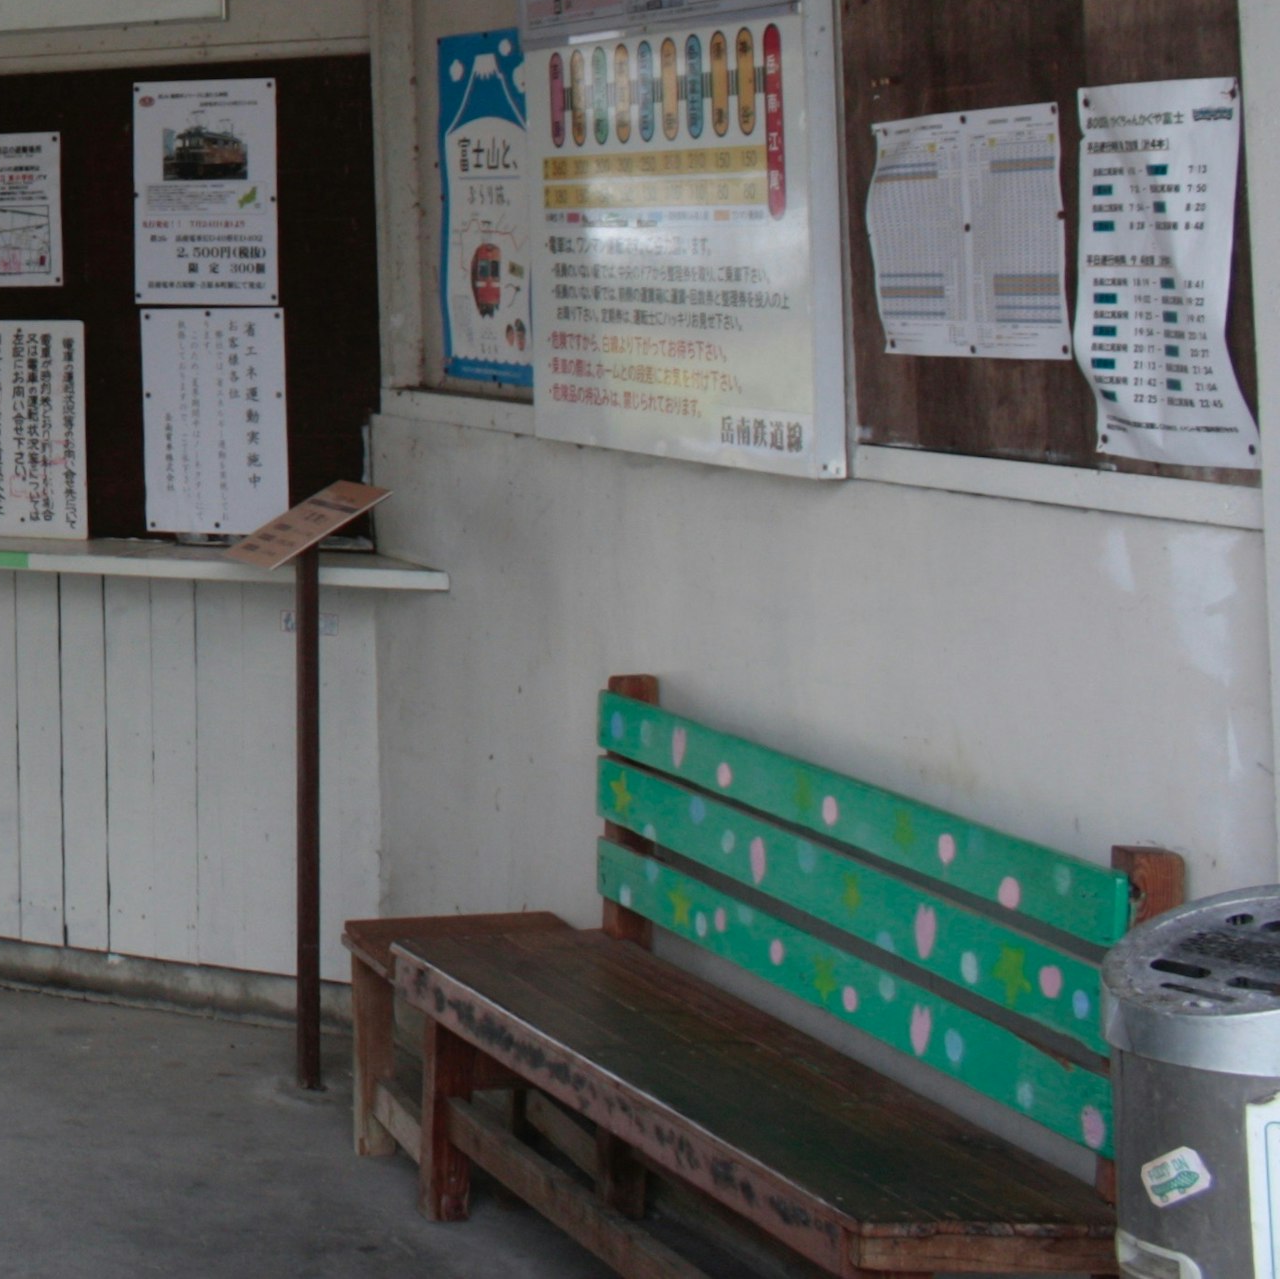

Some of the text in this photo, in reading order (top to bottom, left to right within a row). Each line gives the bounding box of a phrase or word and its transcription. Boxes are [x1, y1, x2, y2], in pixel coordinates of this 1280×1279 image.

[457, 137, 519, 173] 富士山と、
[740, 150, 757, 167] 150
[1186, 183, 1208, 193] 7:50
[227, 319, 241, 400] お客様各位
[243, 321, 263, 489] 省エネ運動実施中
[720, 415, 804, 453] 岳南鉄道線
